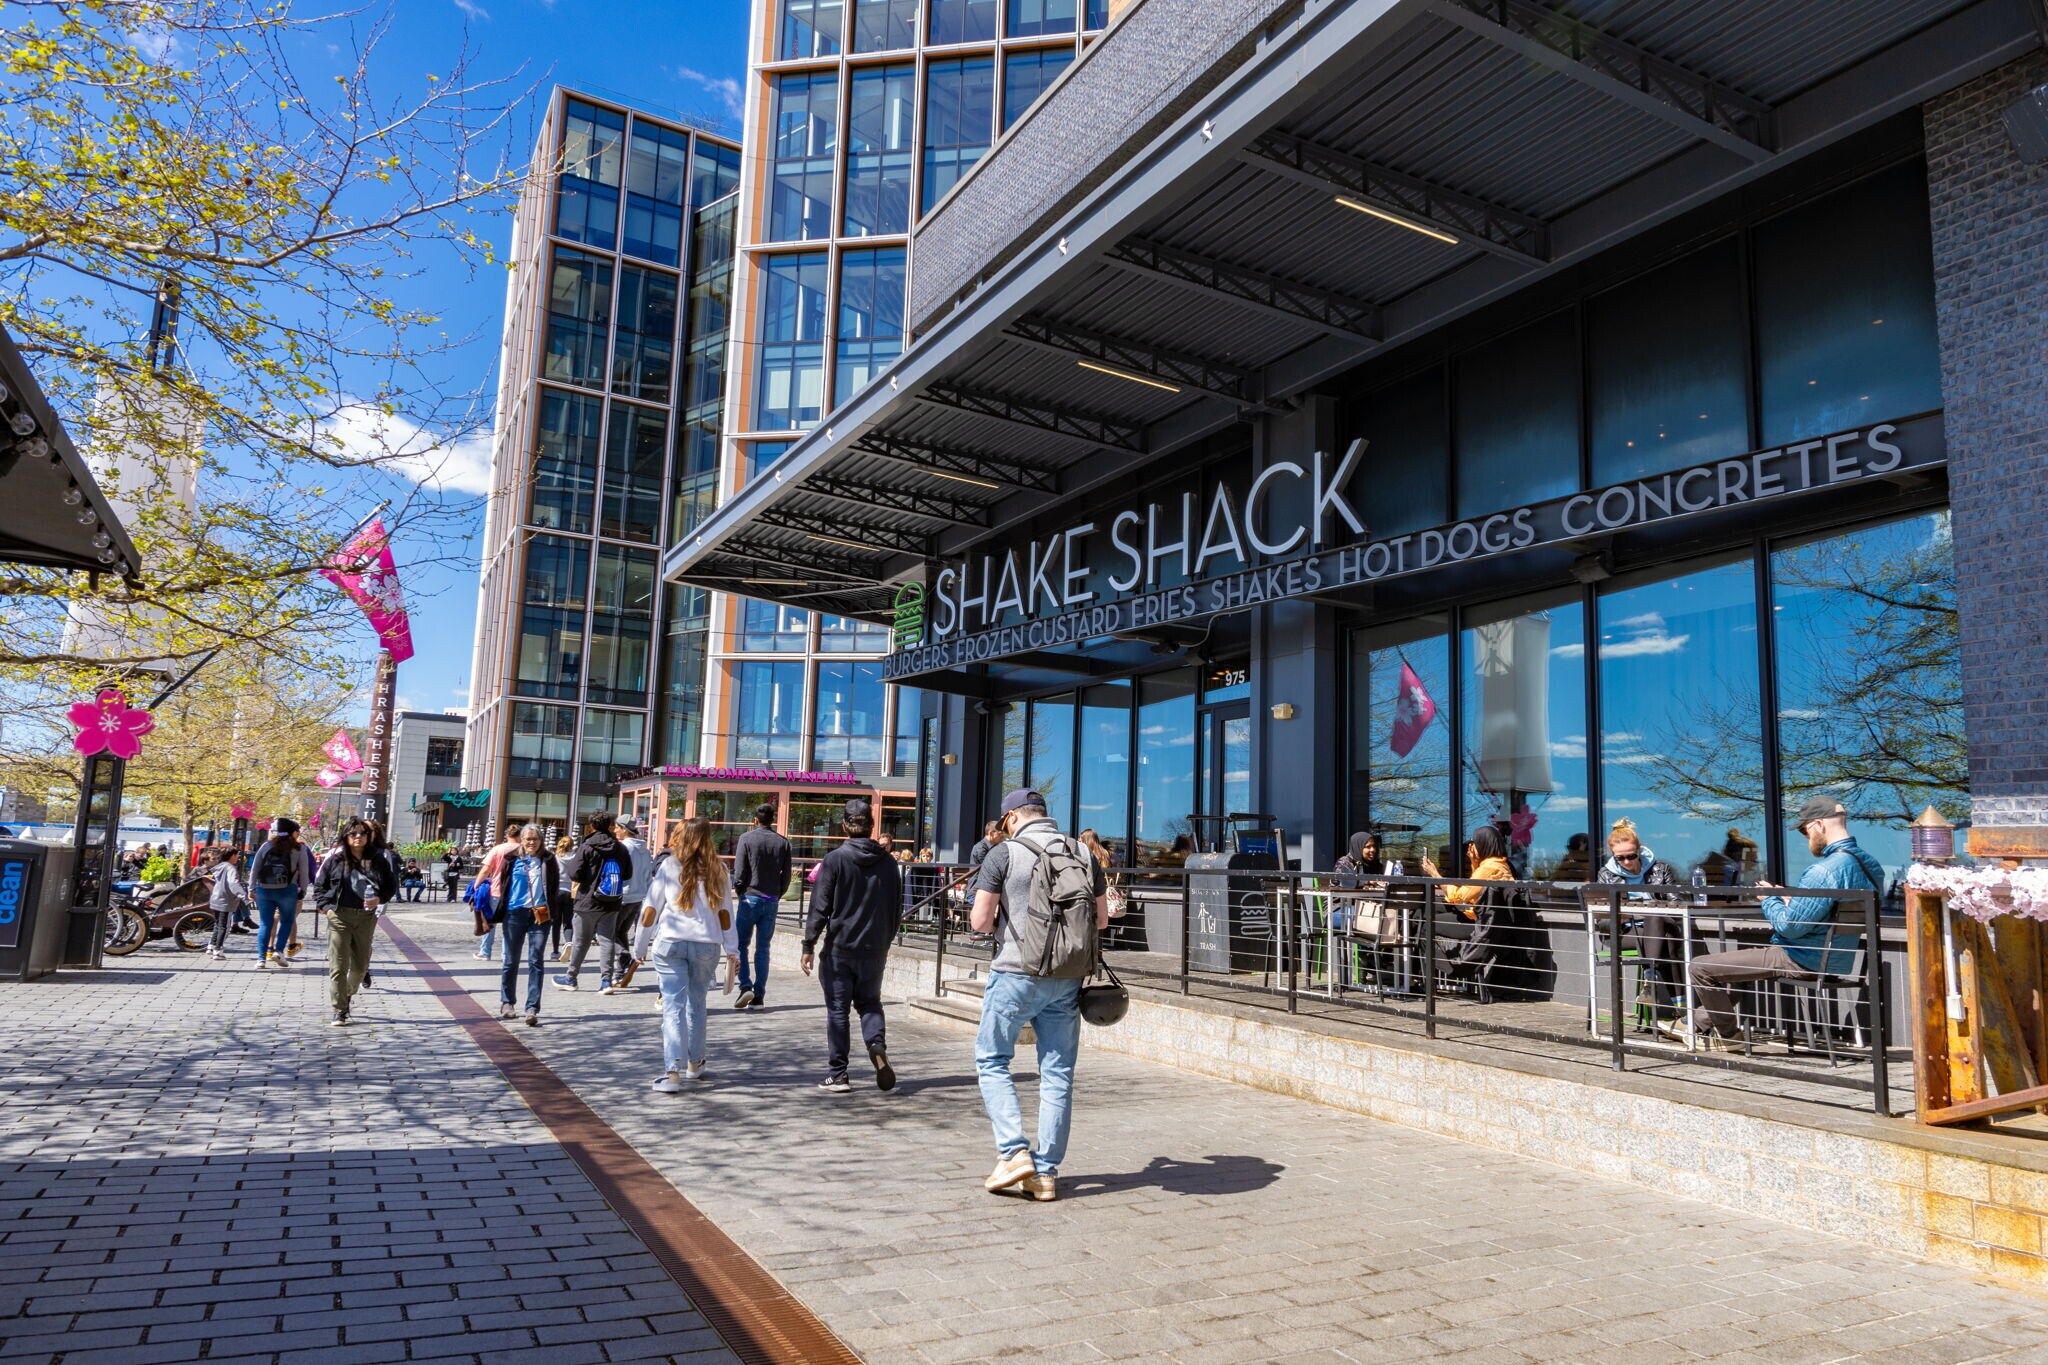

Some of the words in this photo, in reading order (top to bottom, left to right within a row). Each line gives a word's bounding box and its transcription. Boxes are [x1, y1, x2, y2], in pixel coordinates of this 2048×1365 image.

[933, 523, 1097, 636] SHAKE
[1109, 438, 1368, 591] SHACK
[884, 643, 949, 678] BURGERS
[956, 624, 1024, 664] FROZEN
[1029, 604, 1120, 648] CUSTARD
[1131, 586, 1196, 628] FRIES
[1210, 557, 1321, 610] SHAKES
[1339, 536, 1411, 584] HOT
[1421, 508, 1535, 568] DOGS
[1561, 424, 1902, 536] CONCRETES
[1225, 670, 1245, 687] 975
[366, 667, 391, 792] THRASHERS
[665, 765, 702, 778] EASY
[706, 767, 779, 781] COMPANY
[785, 771, 824, 783] WINE
[826, 772, 856, 784] BAR
[453, 787, 492, 808] Grill
[1200, 942, 1216, 951] TRASH
